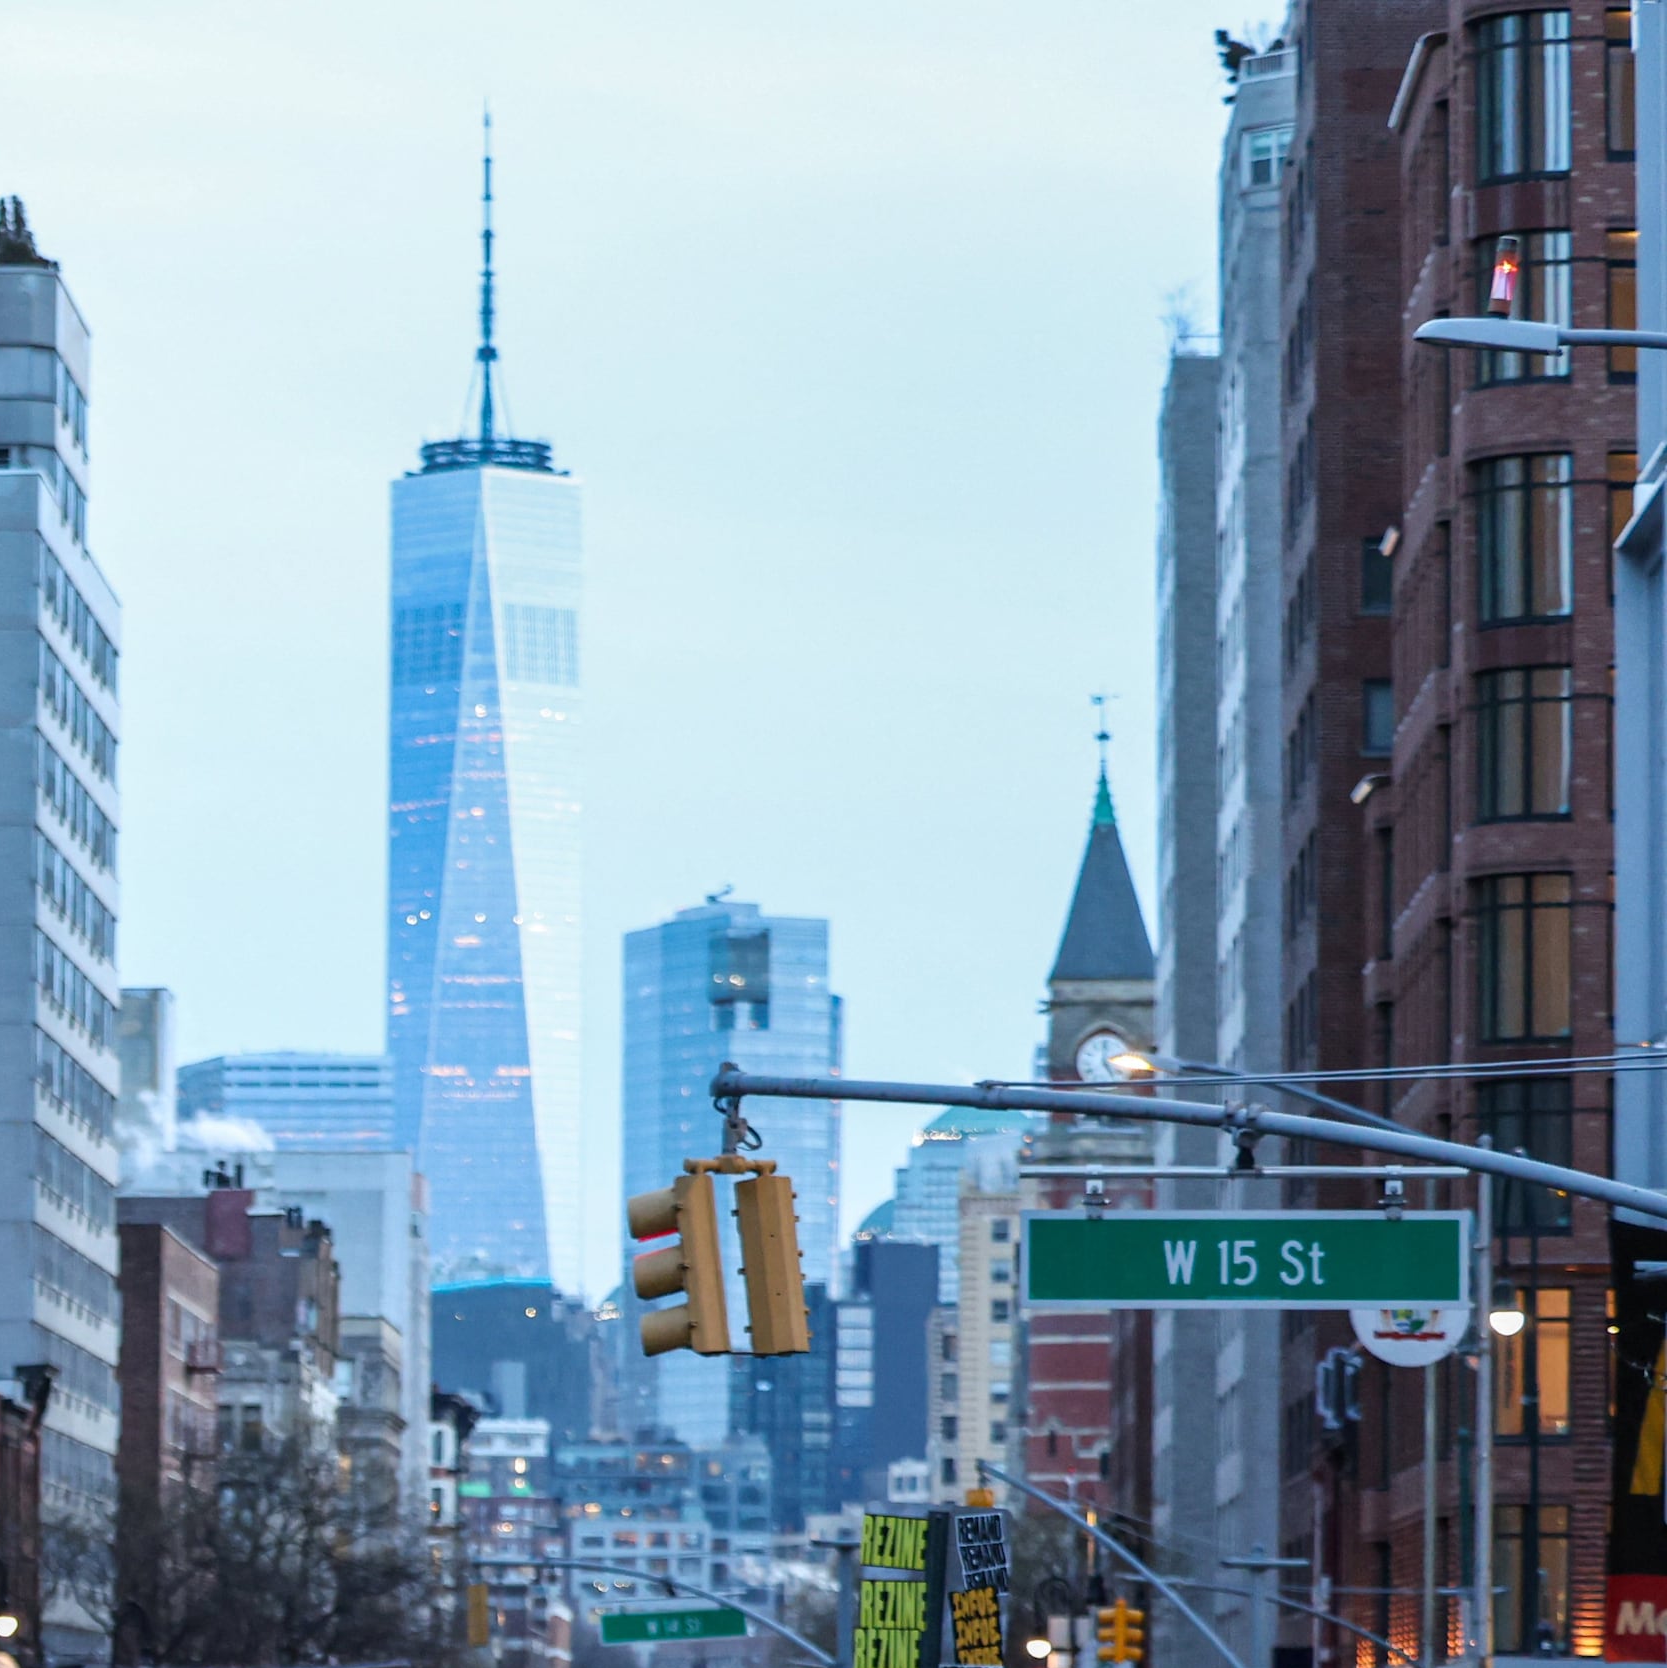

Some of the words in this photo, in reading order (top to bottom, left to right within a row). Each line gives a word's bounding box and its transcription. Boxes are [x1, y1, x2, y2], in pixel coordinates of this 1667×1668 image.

[1164, 1240, 1196, 1285] W
[1217, 1239, 1258, 1285] 15
[1279, 1239, 1325, 1286] St
